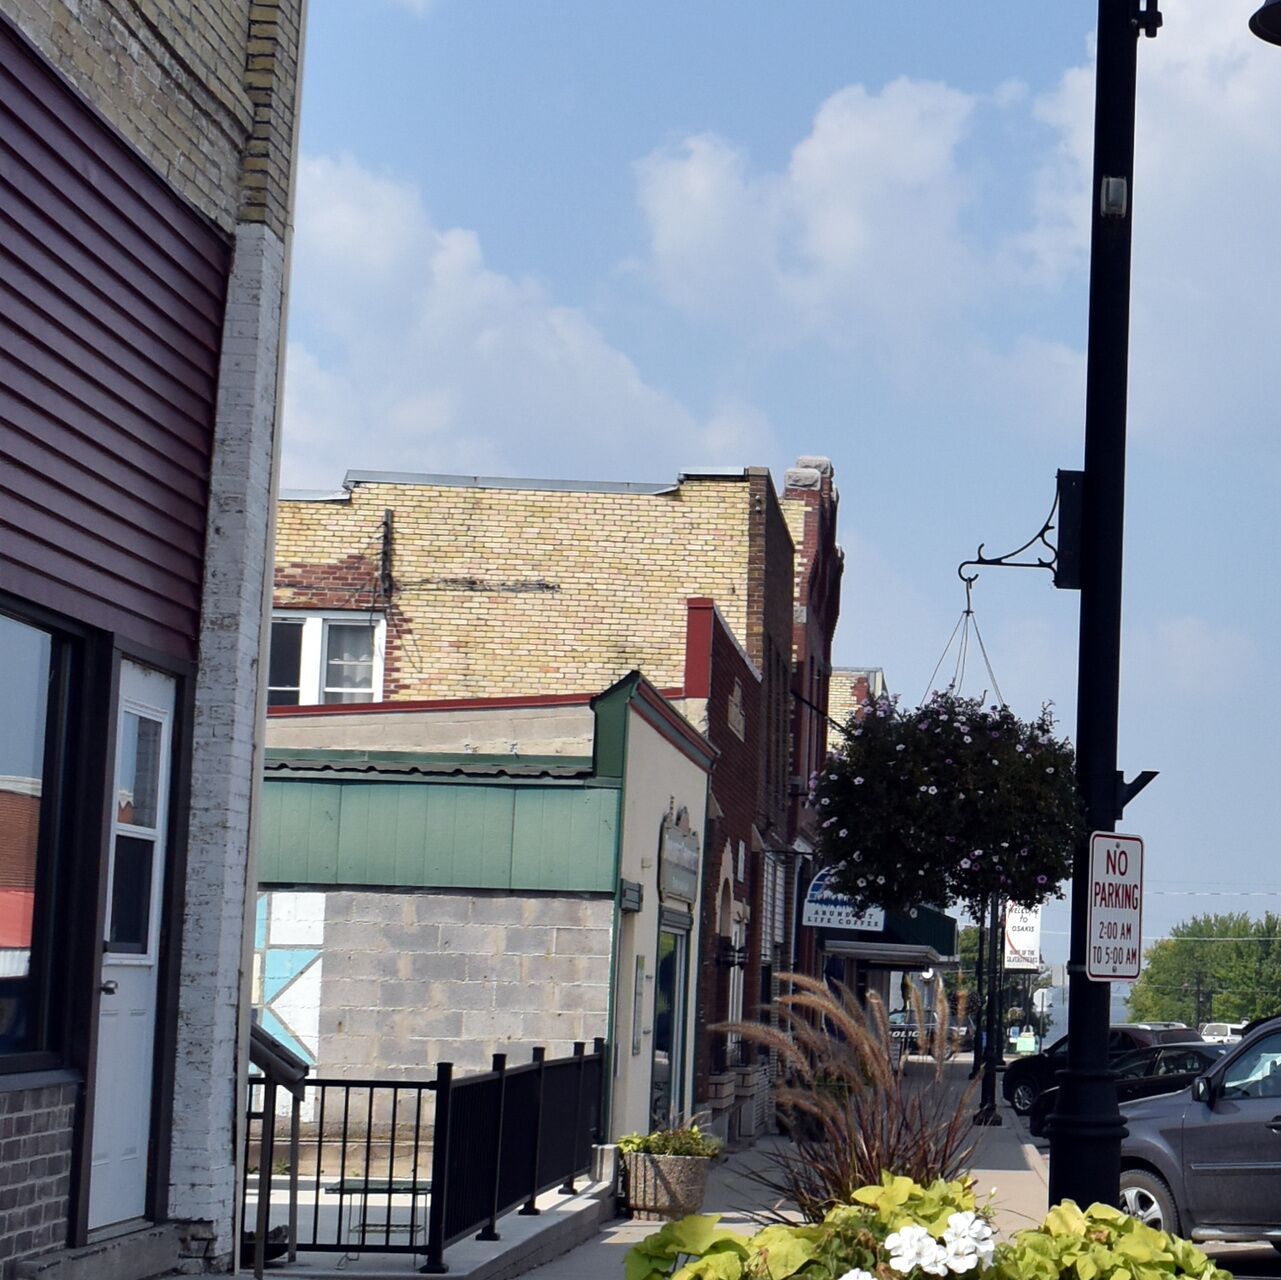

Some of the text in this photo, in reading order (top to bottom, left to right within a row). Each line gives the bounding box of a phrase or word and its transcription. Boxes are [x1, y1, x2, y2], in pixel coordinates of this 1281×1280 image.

[1106, 849, 1129, 876] NO
[1093, 881, 1139, 910] PARKING
[814, 909, 874, 920] ABUNDT
[838, 918, 879, 927] COFFEE
[1011, 925, 1035, 933] OSAKIS
[1099, 921, 1132, 940] 2:00 AM
[1092, 946, 1137, 965] TO 5:00 AM
[889, 1030, 920, 1038] OLIC
